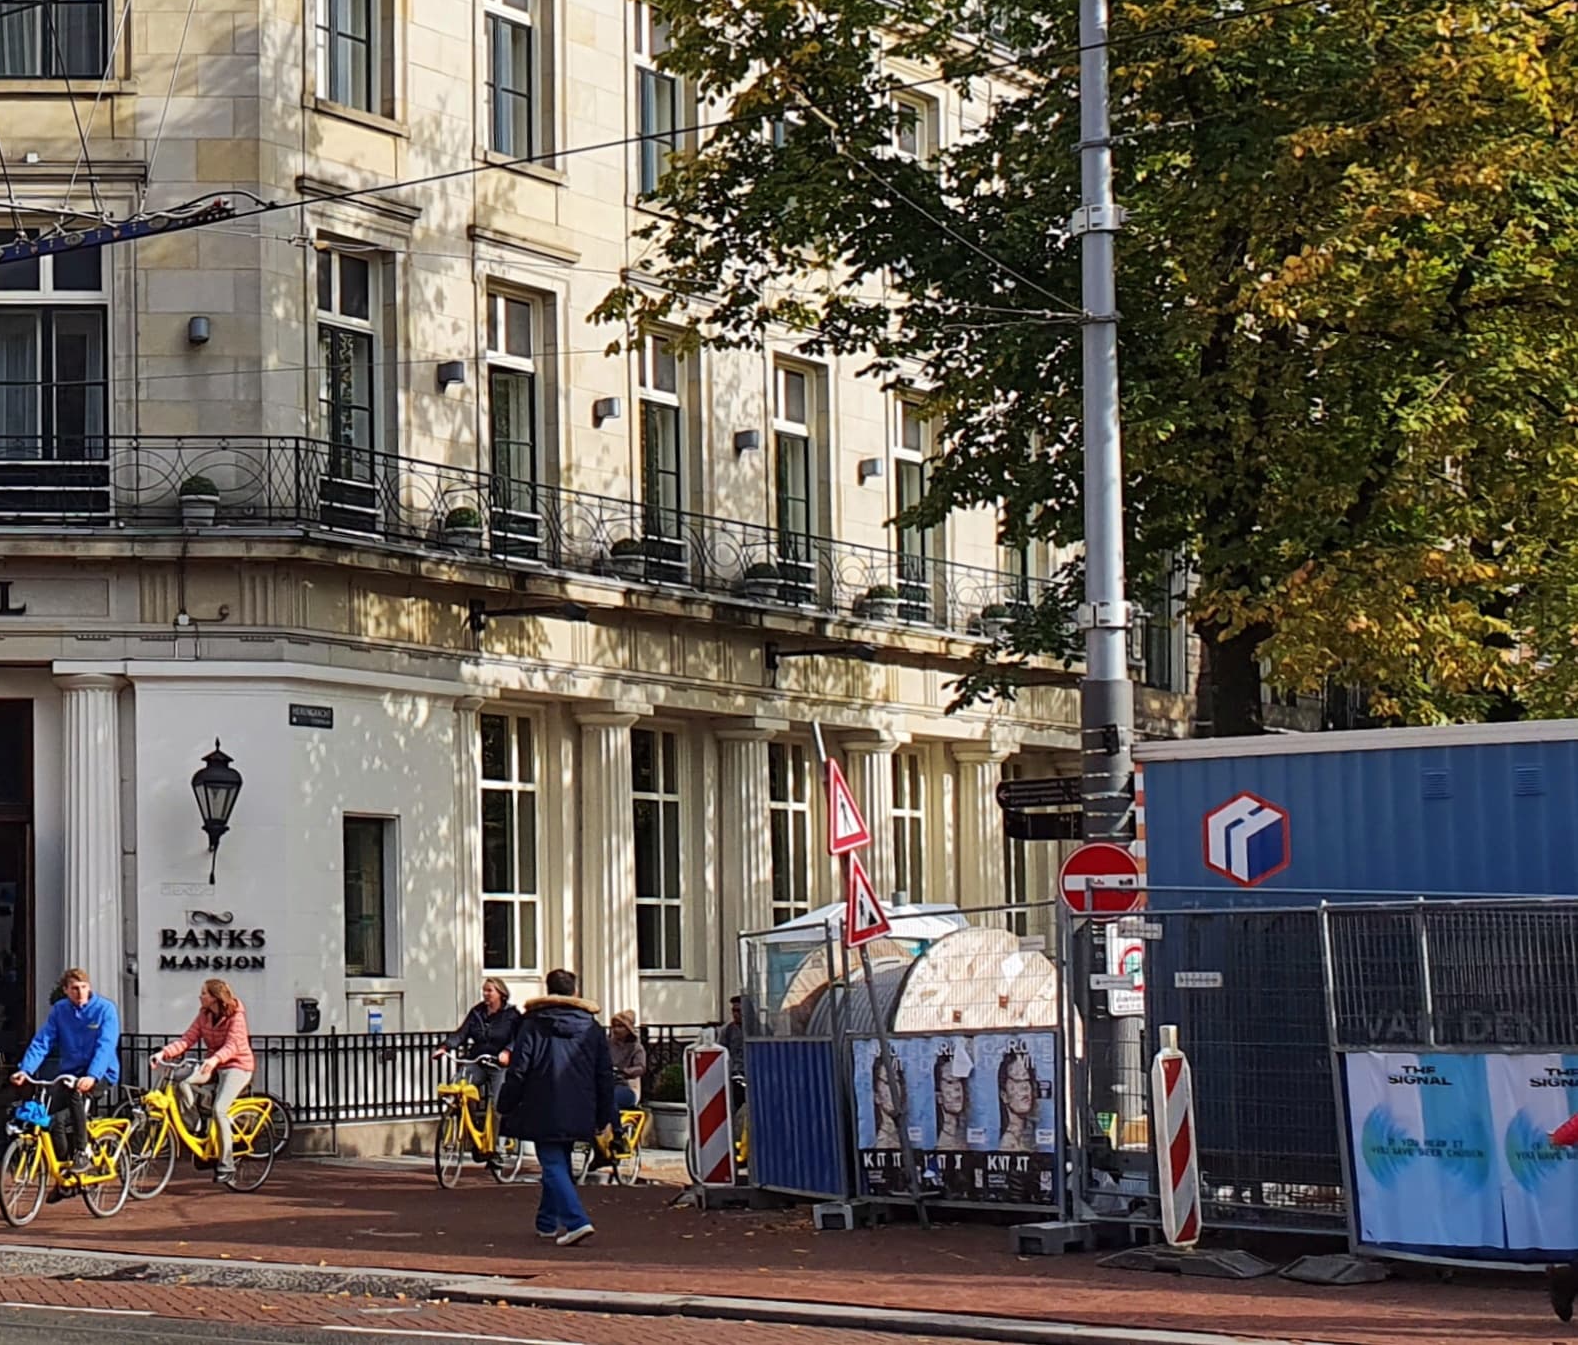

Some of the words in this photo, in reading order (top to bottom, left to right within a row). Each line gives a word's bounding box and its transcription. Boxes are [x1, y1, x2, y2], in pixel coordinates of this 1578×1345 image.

[160, 929, 266, 949] BANKS
[159, 955, 267, 970] MANSION
[1388, 1075, 1453, 1086] SIGNAL
